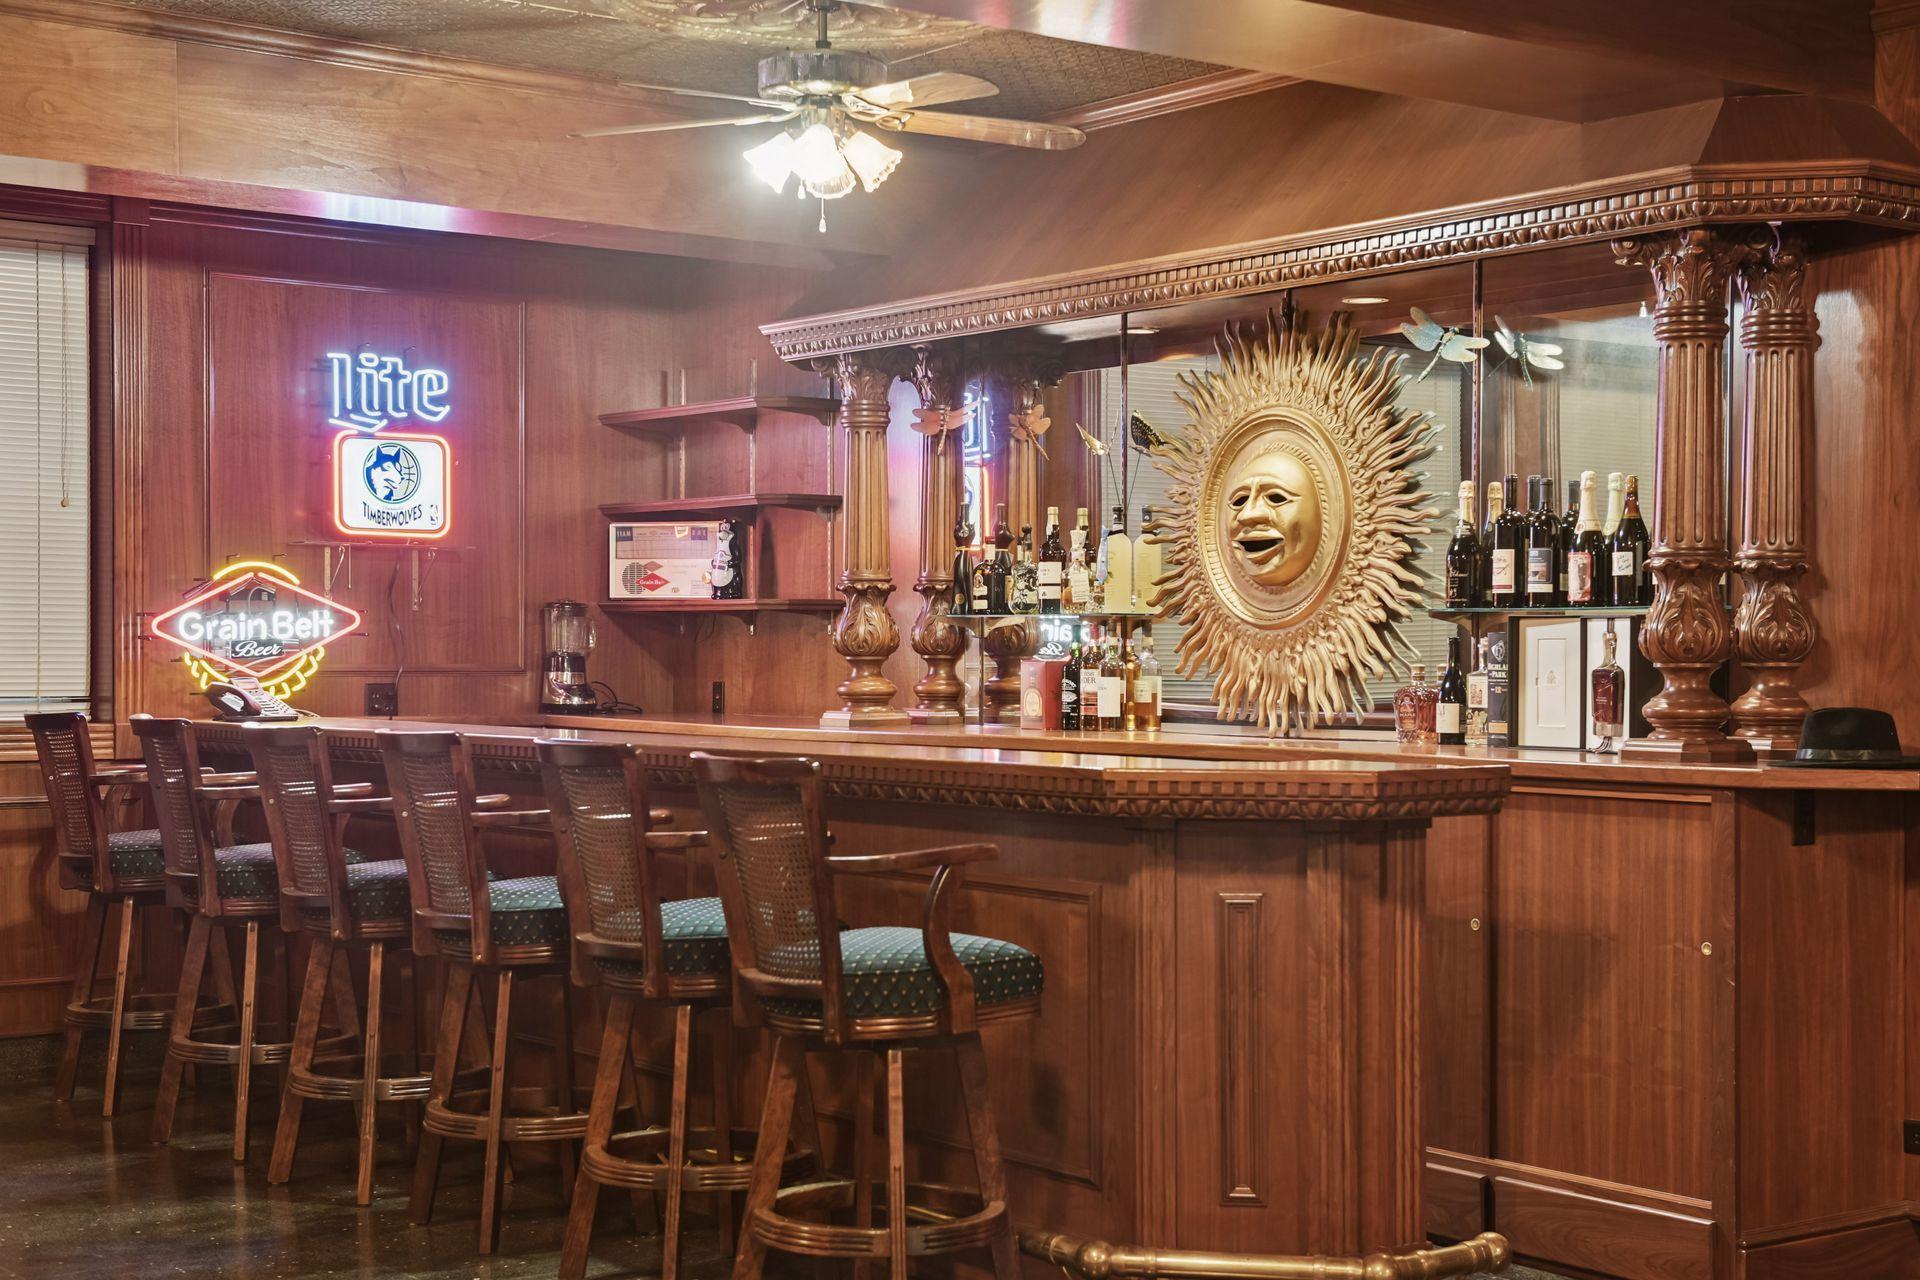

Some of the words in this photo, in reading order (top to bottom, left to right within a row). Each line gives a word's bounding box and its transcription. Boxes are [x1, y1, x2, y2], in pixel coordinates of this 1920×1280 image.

[327, 352, 450, 433] Lite
[362, 501, 422, 527] TIMBERWOLVES
[179, 611, 267, 641] Grain
[272, 609, 335, 640] Belt
[232, 640, 282, 658] Beer
